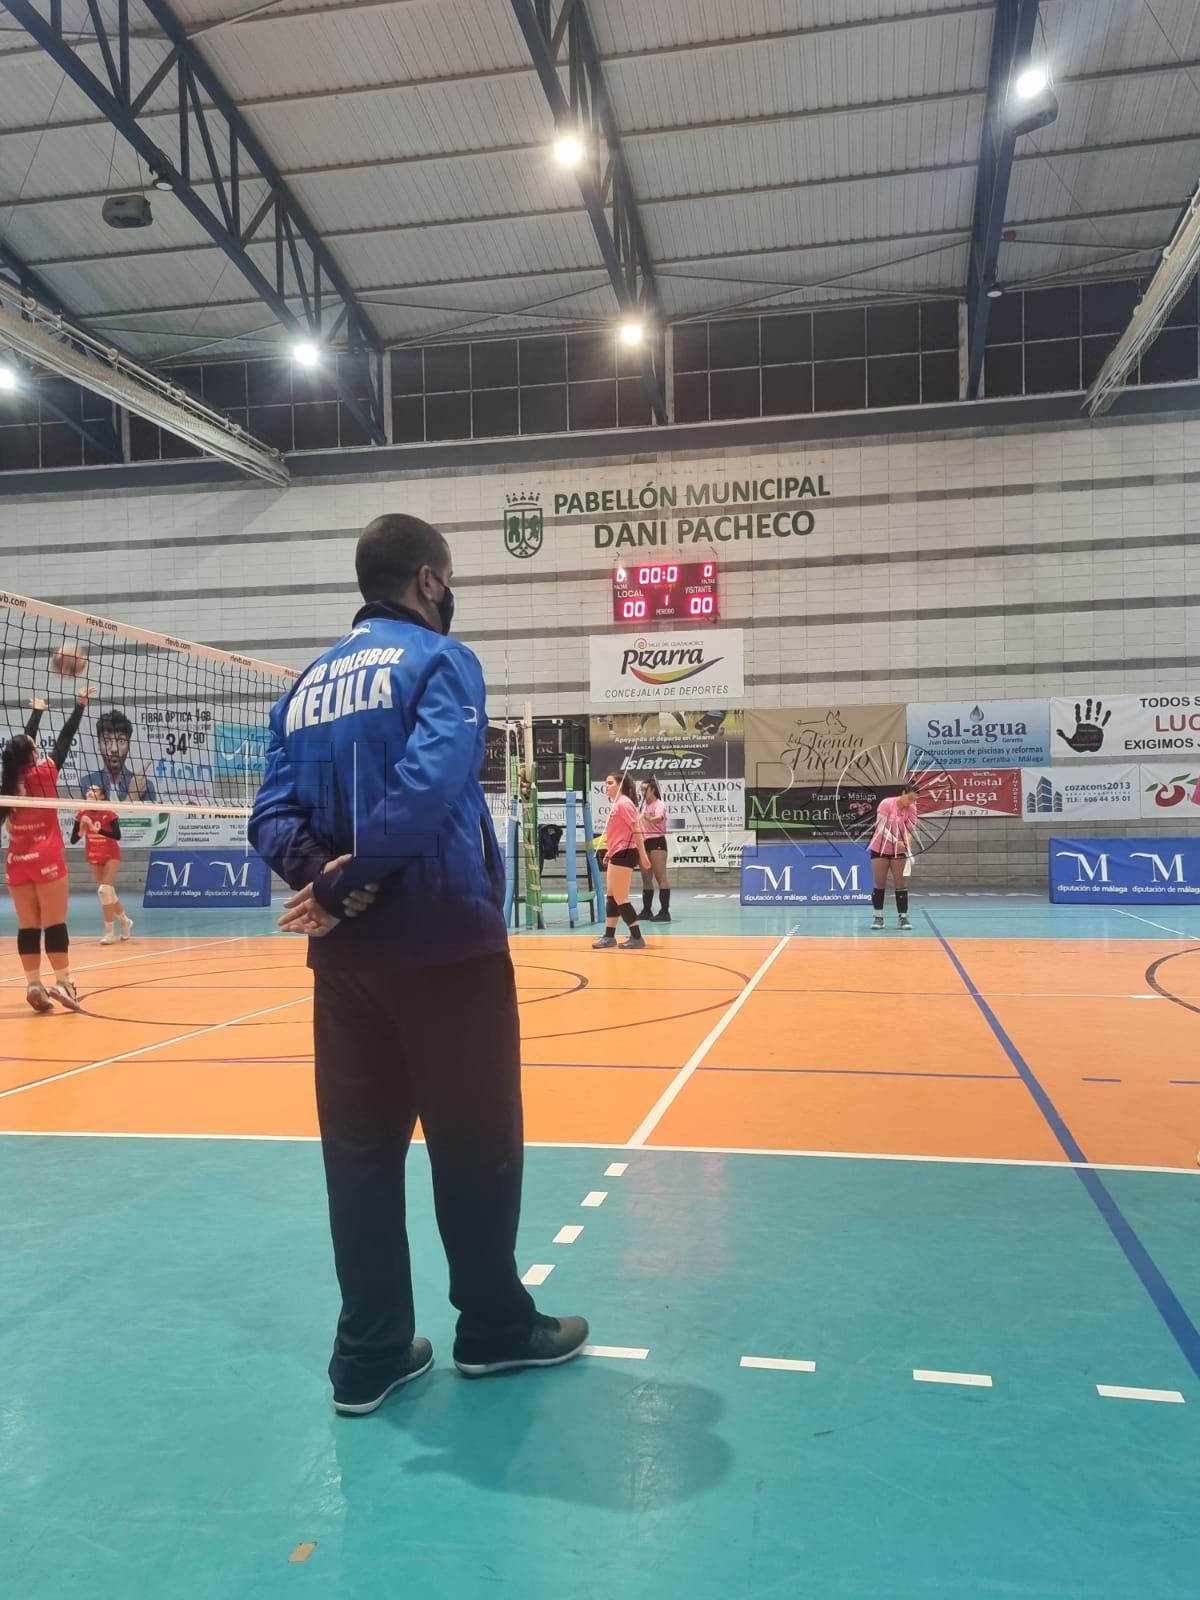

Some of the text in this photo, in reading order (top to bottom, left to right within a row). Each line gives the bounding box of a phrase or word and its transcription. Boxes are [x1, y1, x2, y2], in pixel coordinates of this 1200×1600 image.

[554, 475, 831, 514] PABELLÓN MUNICIPAL
[594, 510, 815, 548] DANI PACHECO
[617, 589, 645, 598] LOCAL
[685, 586, 712, 594] VISITANTE
[623, 601, 645, 618] 00
[690, 597, 713, 614] 00
[86, 616, 118, 631] rfevb.com
[329, 648, 405, 680] VOLEIBOL
[664, 687, 676, 696] DE
[679, 685, 729, 696] DEPORTES
[286, 667, 393, 737] MELILLA
[1140, 696, 1190, 708] TODOS
[141, 713, 163, 723] FIBRA
[927, 719, 1028, 743] Sal-agua
[802, 729, 864, 749] Tienda
[1124, 738, 1194, 750] EXIGIMOS
[914, 748, 966, 757] Construcciones
[967, 747, 977, 755] de
[977, 747, 1005, 757] piscinas
[1011, 746, 1044, 754] reformas
[620, 756, 703, 770] Islatrans
[780, 747, 870, 771] Pueblo
[665, 782, 742, 793] ALICATADOS
[963, 777, 1003, 786] Hostal
[1064, 782, 1131, 791] cozacons2013
[707, 791, 727, 801] S.L.
[928, 789, 998, 805] Villega
[681, 805, 692, 813] EN
[694, 804, 738, 813] GENERAL
[677, 835, 710, 843] CHAPA
[691, 845, 698, 853] Y
[673, 856, 716, 864] PINTURA
[1056, 851, 1111, 882] M
[1129, 852, 1187, 883] M
[151, 861, 194, 887] M
[209, 861, 252, 887] M
[745, 864, 793, 892] M
[811, 864, 861, 892] M
[1057, 884, 1128, 894] diputación de málaga
[1131, 885, 1166, 894] diputación
[1167, 885, 1176, 893] de
[744, 894, 774, 902] diputación
[784, 893, 807, 901] málaga
[811, 893, 841, 902] diputación
[851, 893, 872, 902] málag
